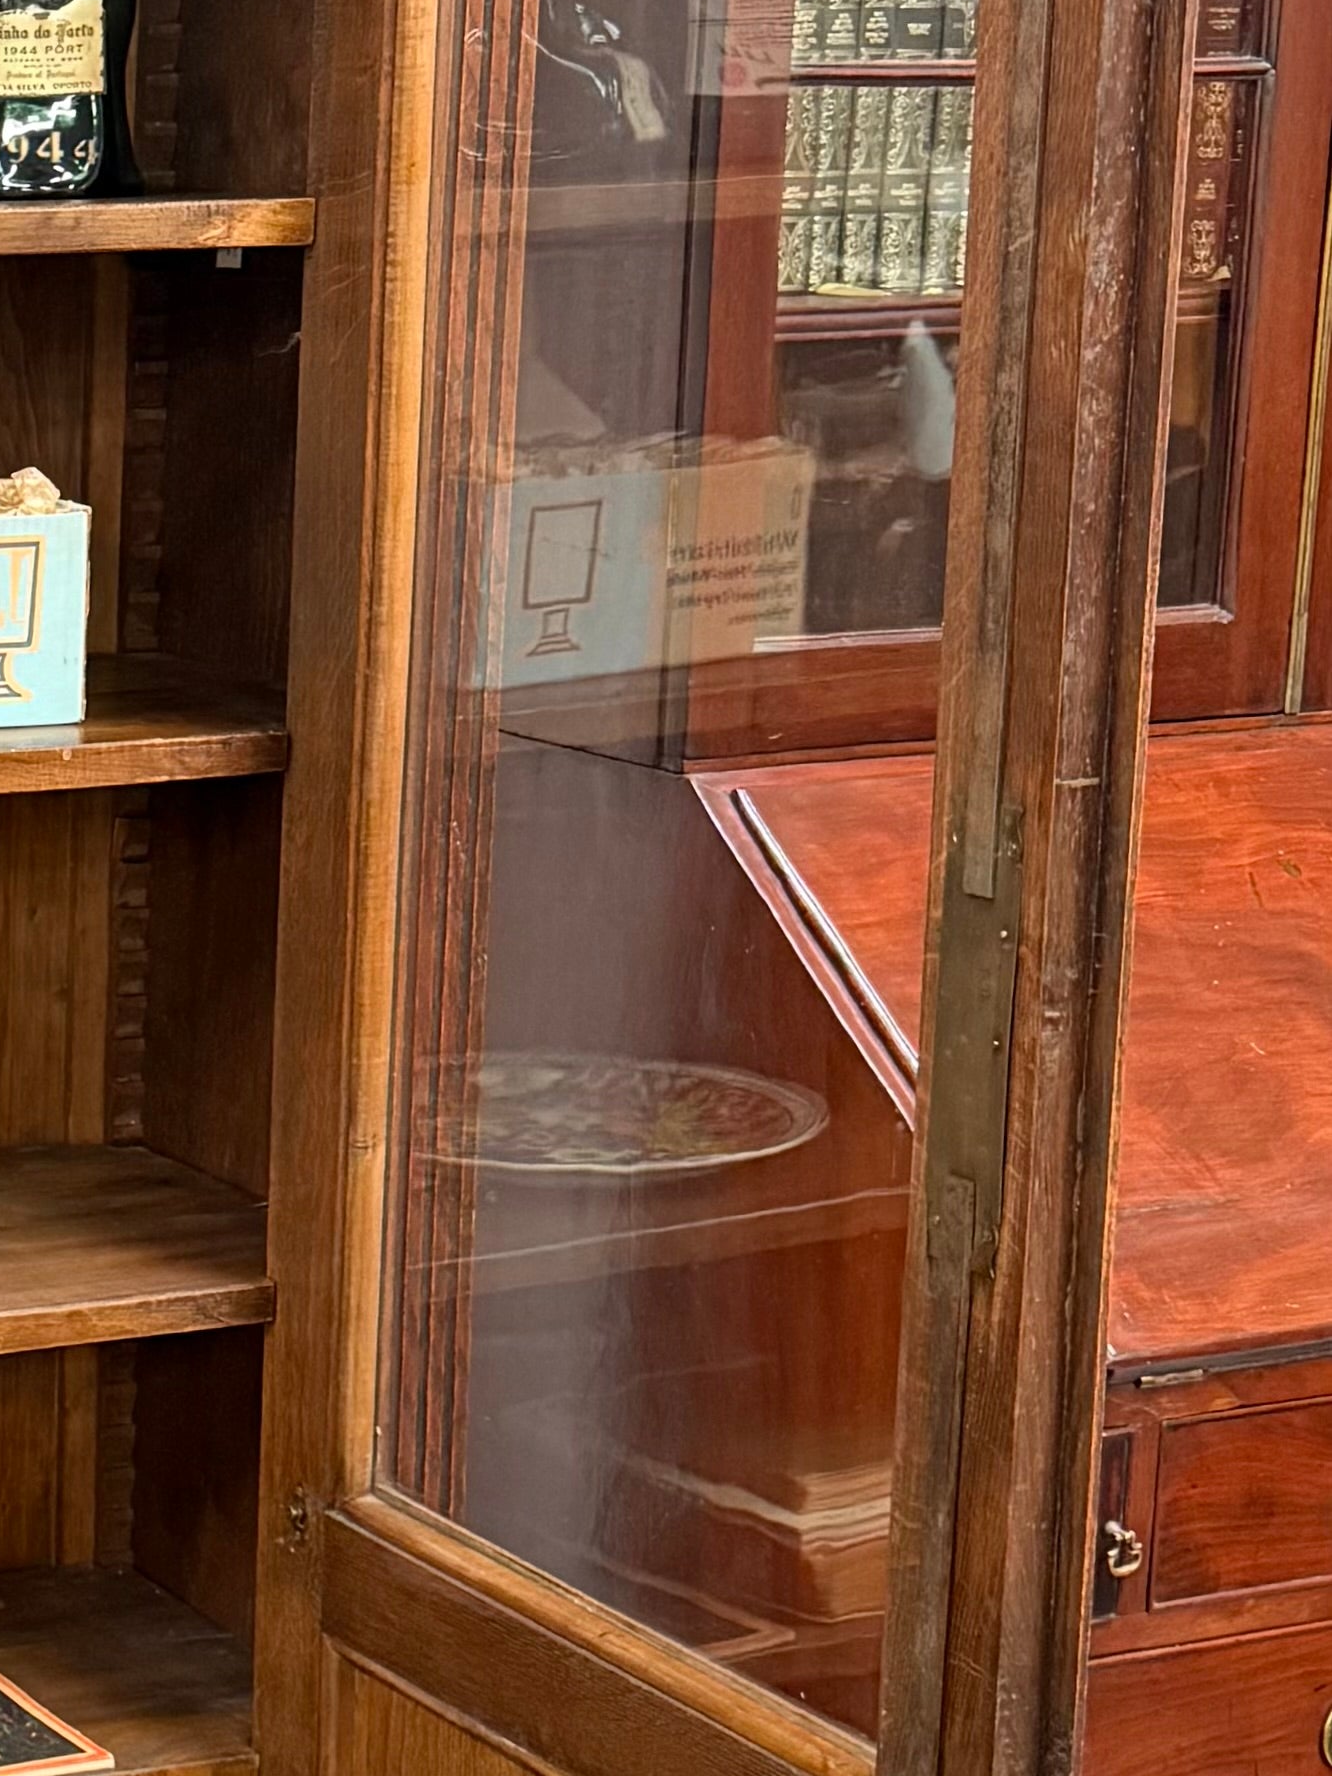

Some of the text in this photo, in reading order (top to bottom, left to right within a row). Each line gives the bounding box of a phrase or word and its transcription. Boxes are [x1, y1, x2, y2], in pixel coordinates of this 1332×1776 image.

[34, 25, 50, 39] do
[3, 44, 84, 56] 1944 PORT
